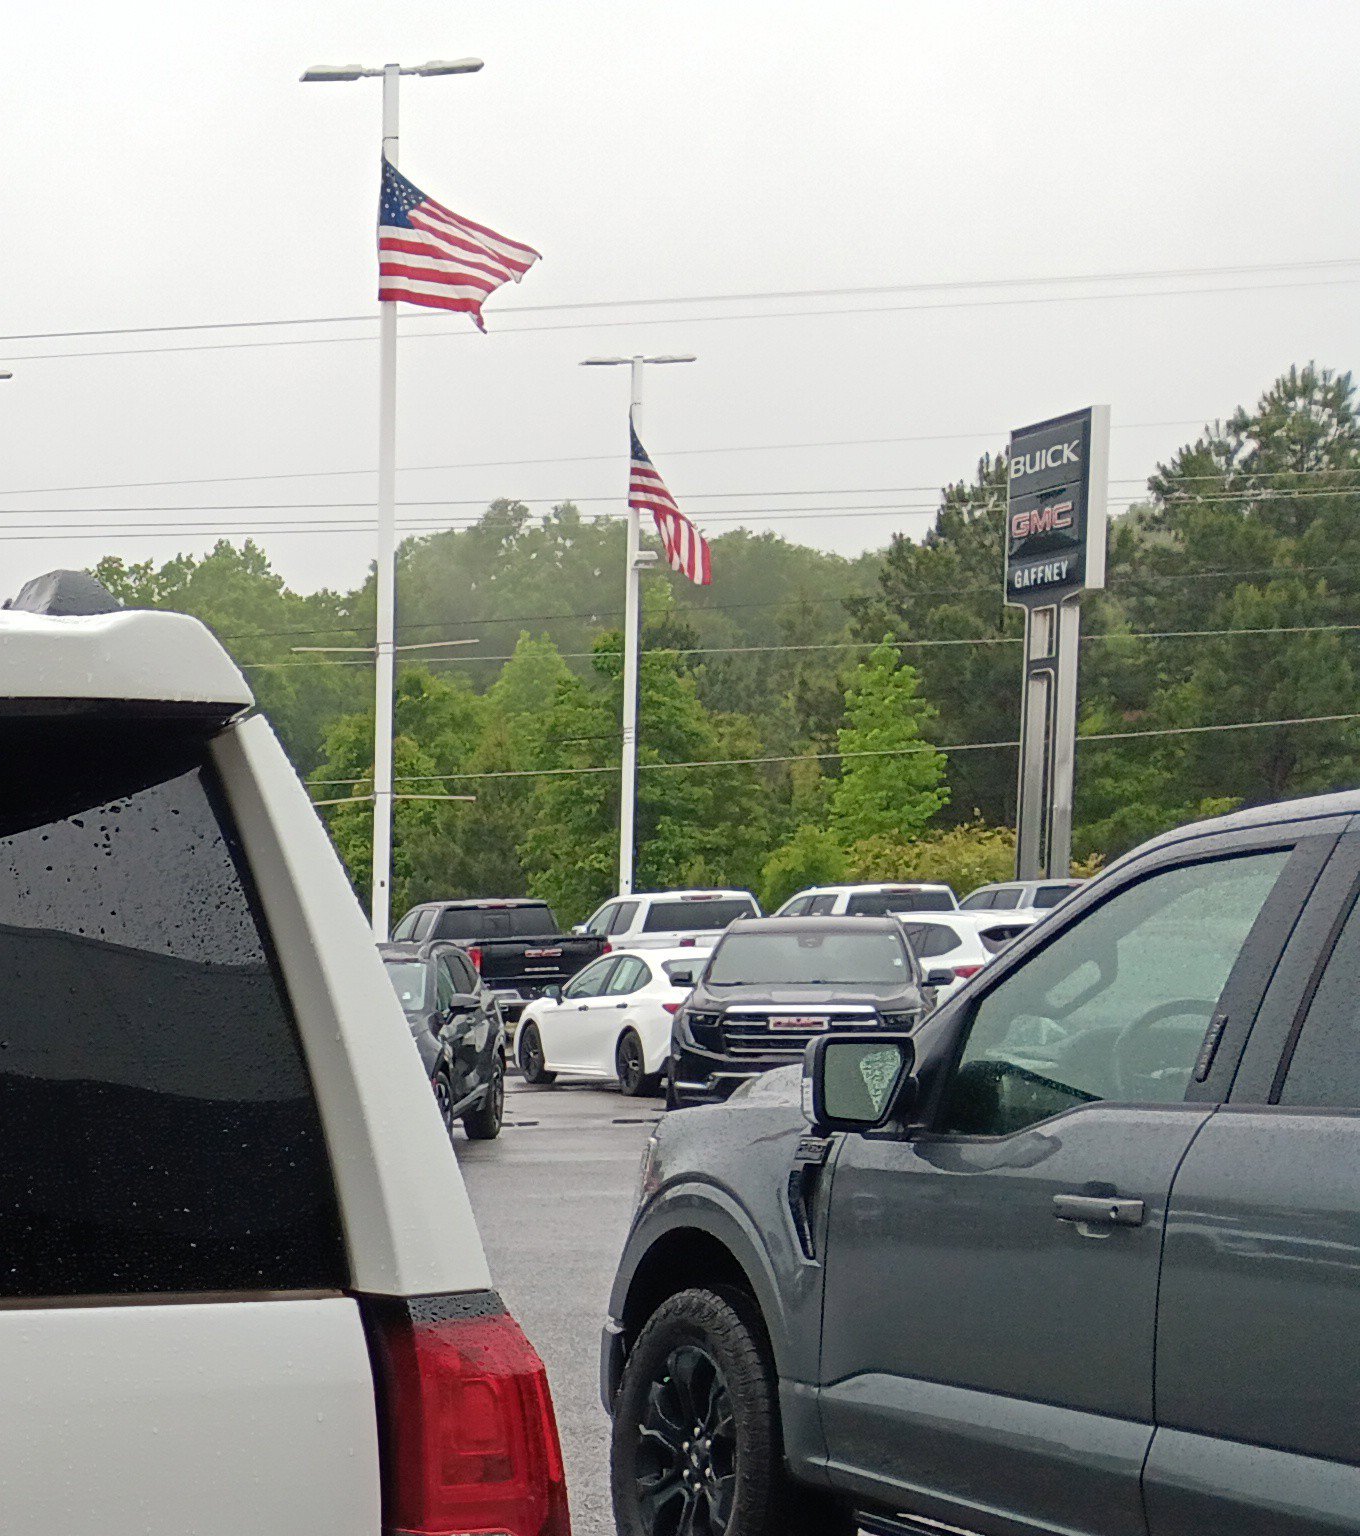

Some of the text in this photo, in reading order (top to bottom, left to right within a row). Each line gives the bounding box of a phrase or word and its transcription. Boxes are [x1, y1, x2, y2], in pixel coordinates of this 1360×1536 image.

[1010, 439, 1080, 479] BUICK
[1012, 501, 1074, 539] GMC
[1014, 560, 1069, 589] GAFFNEY
